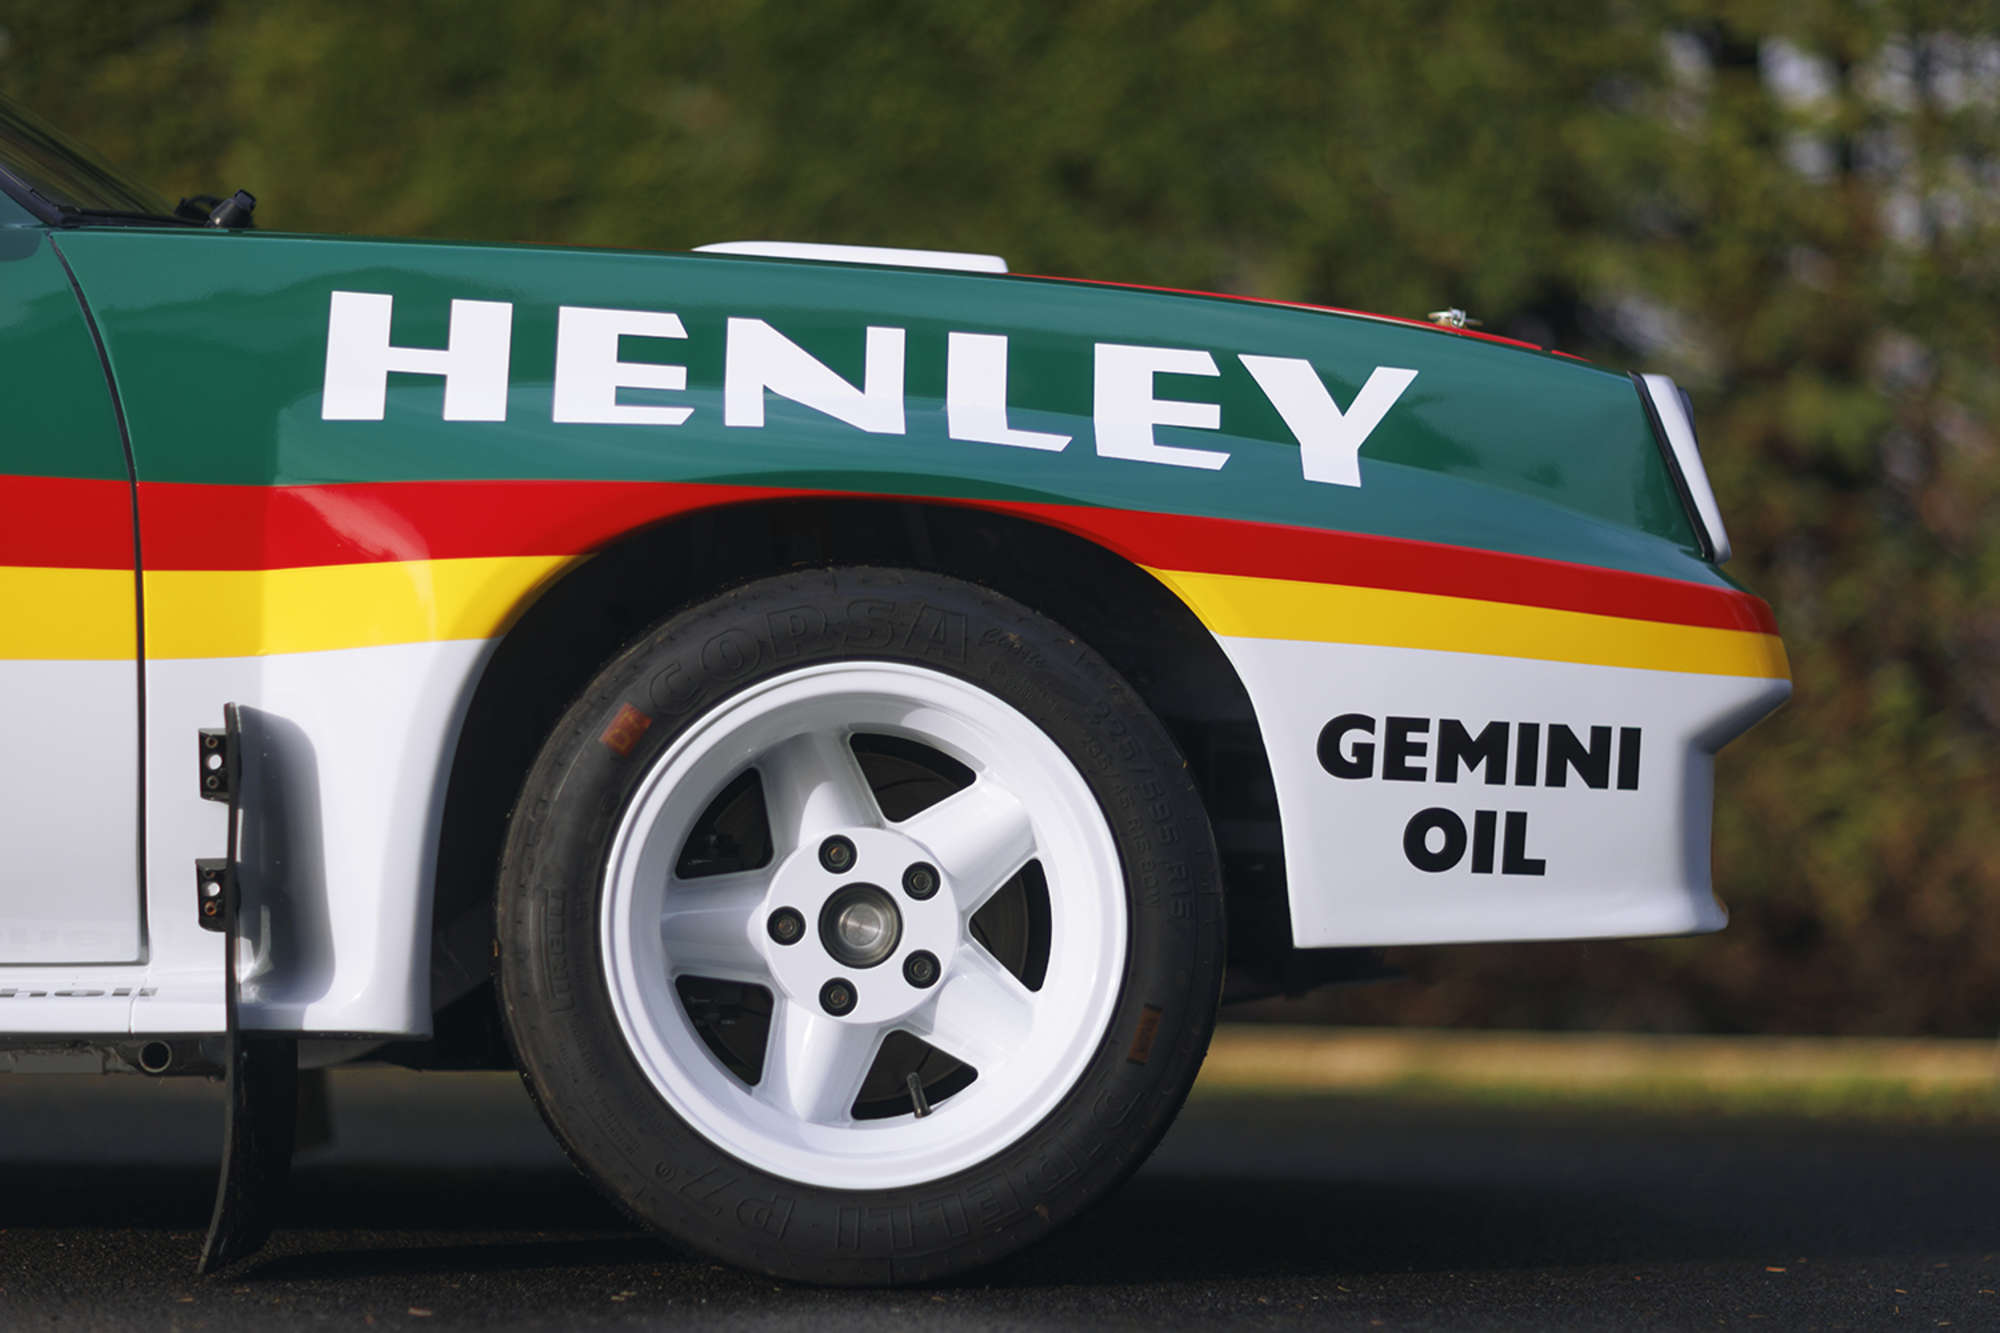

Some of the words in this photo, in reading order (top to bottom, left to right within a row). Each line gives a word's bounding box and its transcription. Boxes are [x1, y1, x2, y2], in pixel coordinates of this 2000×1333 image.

[321, 290, 1419, 488] HENLEY
[648, 599, 968, 714] CORSA
[1317, 713, 1642, 790] GEMINI
[1403, 807, 1546, 876] OIL
[832, 1088, 1143, 1250] PIRELLI
